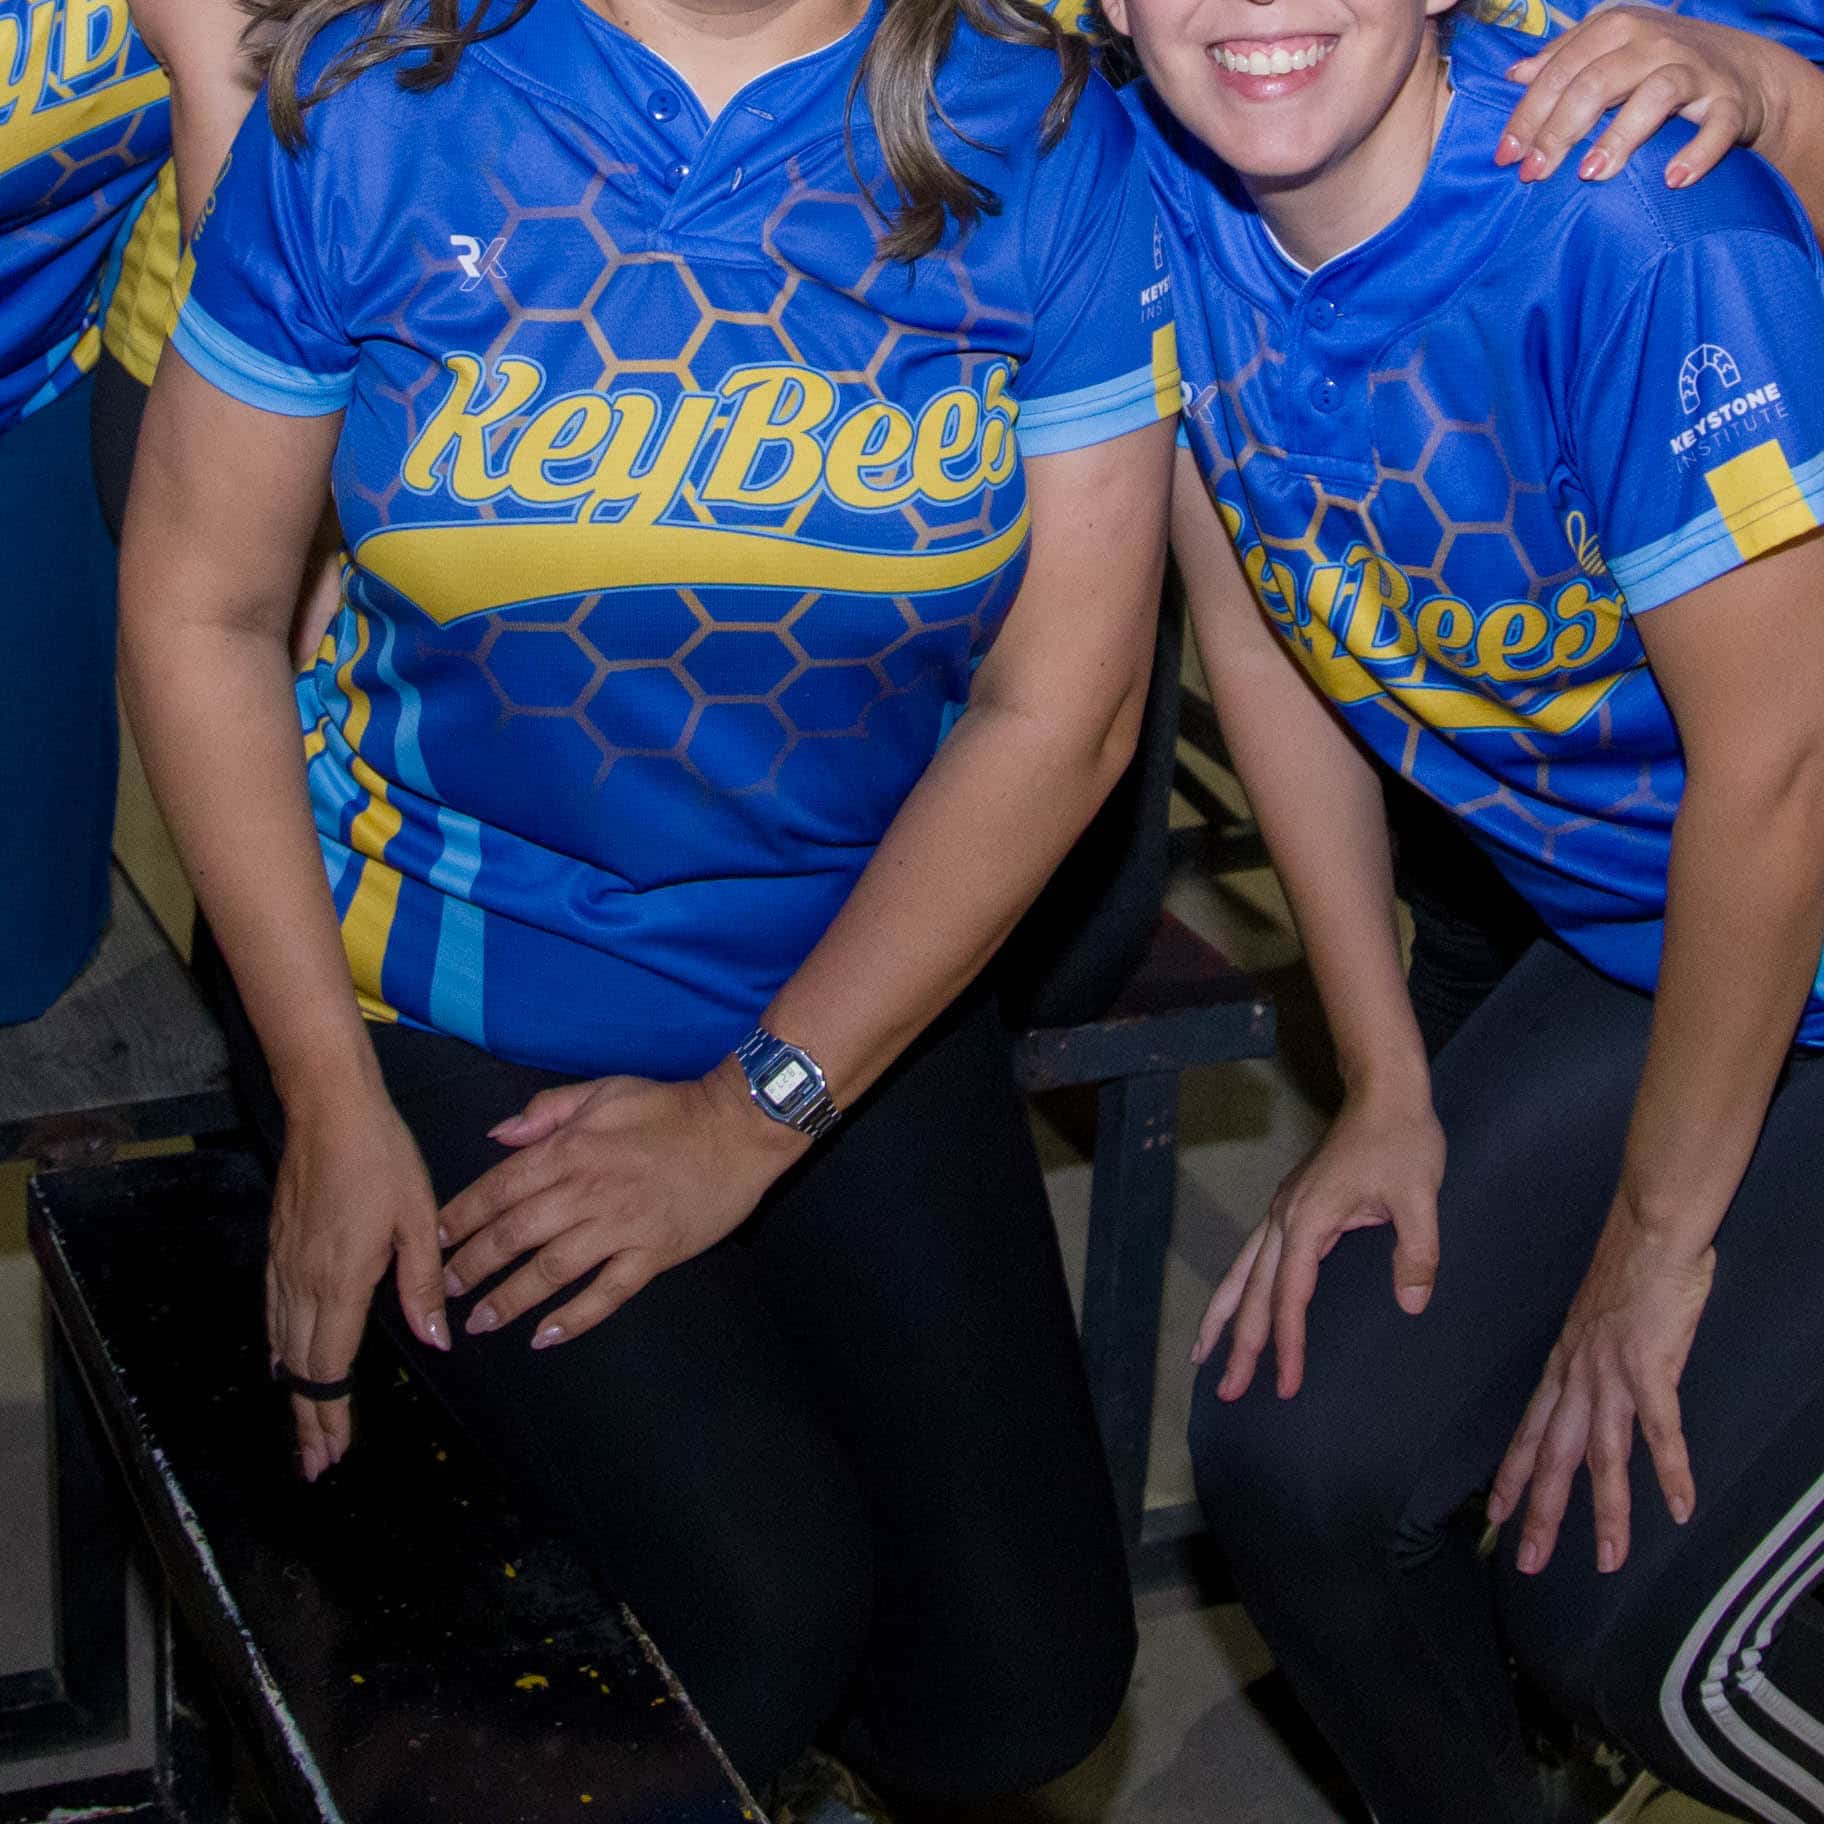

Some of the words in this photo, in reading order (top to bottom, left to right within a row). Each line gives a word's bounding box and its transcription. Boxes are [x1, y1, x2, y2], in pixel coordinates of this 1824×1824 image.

[1140, 274, 1173, 307] KEYS
[401, 350, 1022, 528] KeyBees
[1669, 381, 1782, 456] KEYSTONE
[1673, 401, 1790, 475] INSTITUTE
[1216, 496, 1628, 684] eyBees
